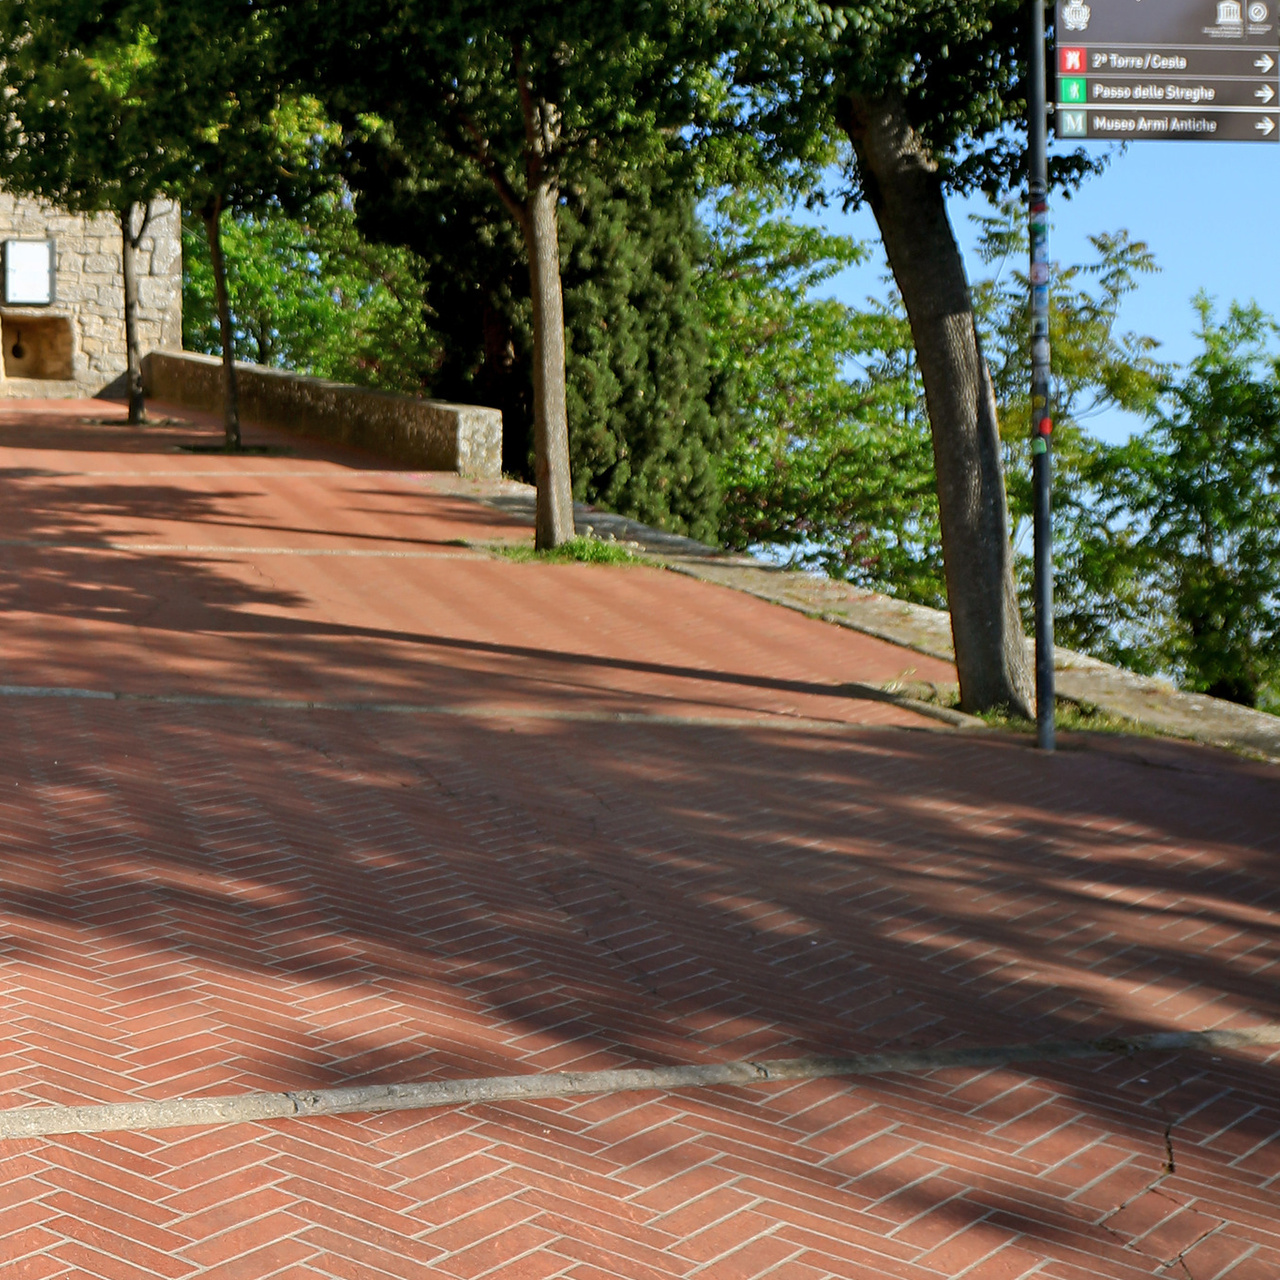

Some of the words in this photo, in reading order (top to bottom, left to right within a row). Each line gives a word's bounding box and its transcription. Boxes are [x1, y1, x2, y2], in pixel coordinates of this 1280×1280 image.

[1093, 83, 1131, 99] Passo
[1132, 84, 1164, 99] delle
[1165, 84, 1215, 103] Streghe
[1093, 116, 1135, 131] Museo
[1136, 116, 1169, 131] Armi
[1169, 117, 1218, 132] Antiche
